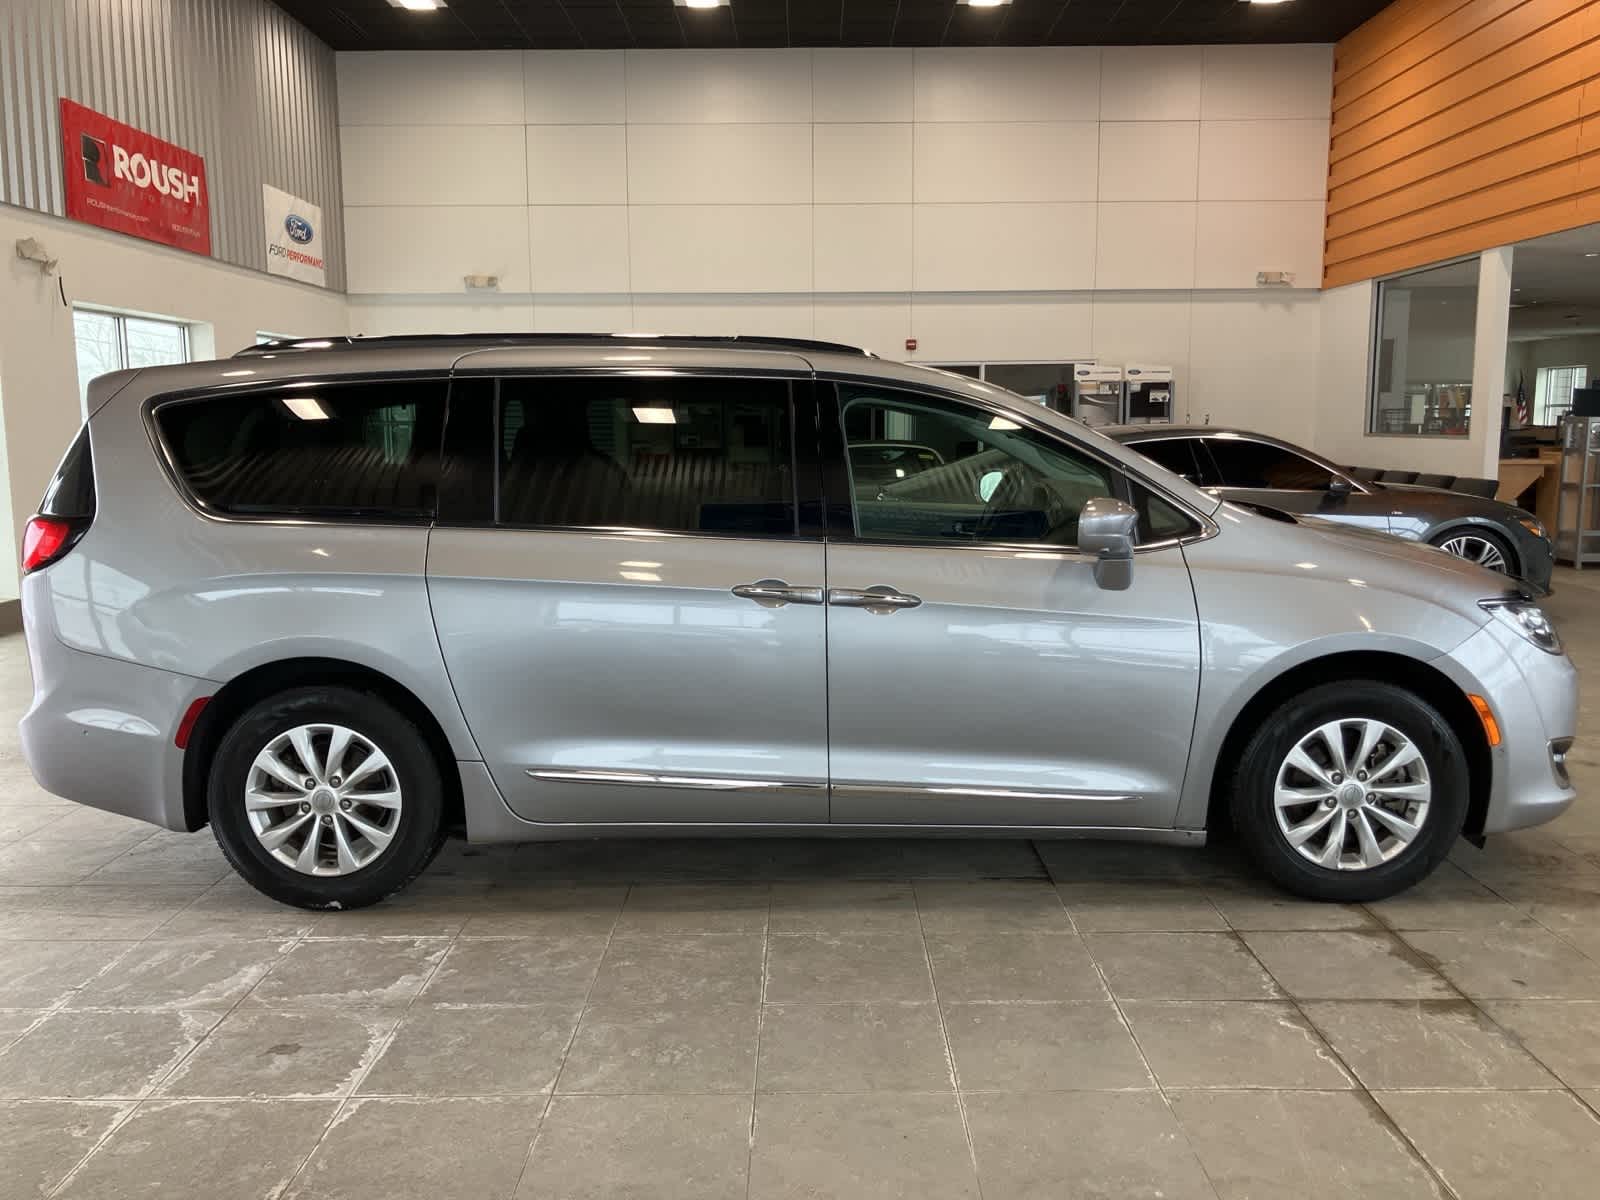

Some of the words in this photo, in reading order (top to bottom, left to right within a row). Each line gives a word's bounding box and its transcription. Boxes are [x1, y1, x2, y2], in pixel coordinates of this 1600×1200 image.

[112, 144, 200, 206] ROUSH
[289, 218, 307, 241] Ford
[269, 244, 287, 258] FORD
[287, 250, 324, 270] PERFORMANC
